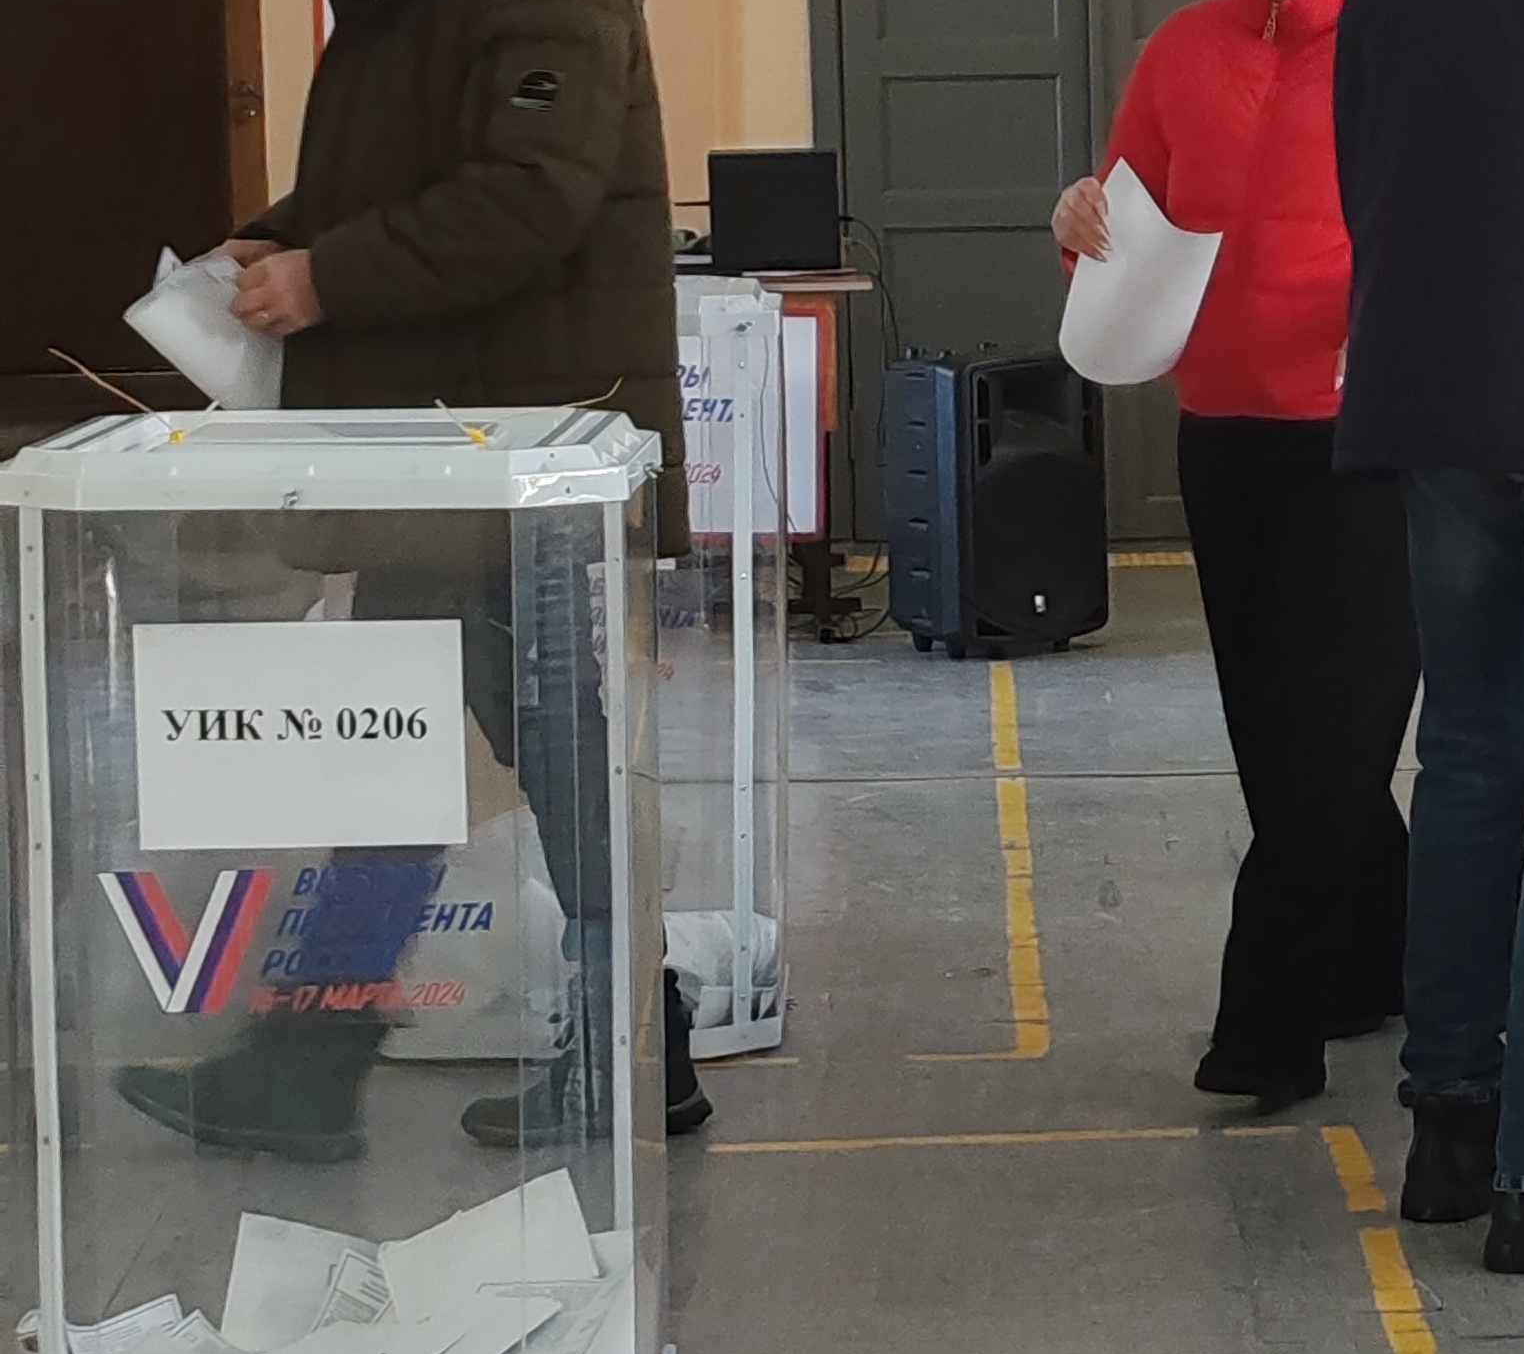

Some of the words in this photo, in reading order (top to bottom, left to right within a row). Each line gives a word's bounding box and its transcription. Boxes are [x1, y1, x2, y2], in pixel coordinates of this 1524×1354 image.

[685, 464, 721, 484] 024
[161, 709, 263, 741] УИК
[277, 708, 322, 741] №
[336, 707, 428, 740] 0206
[277, 901, 494, 937] ПЕНТА
[97, 869, 276, 1014] V
[410, 981, 467, 1008] 2024
